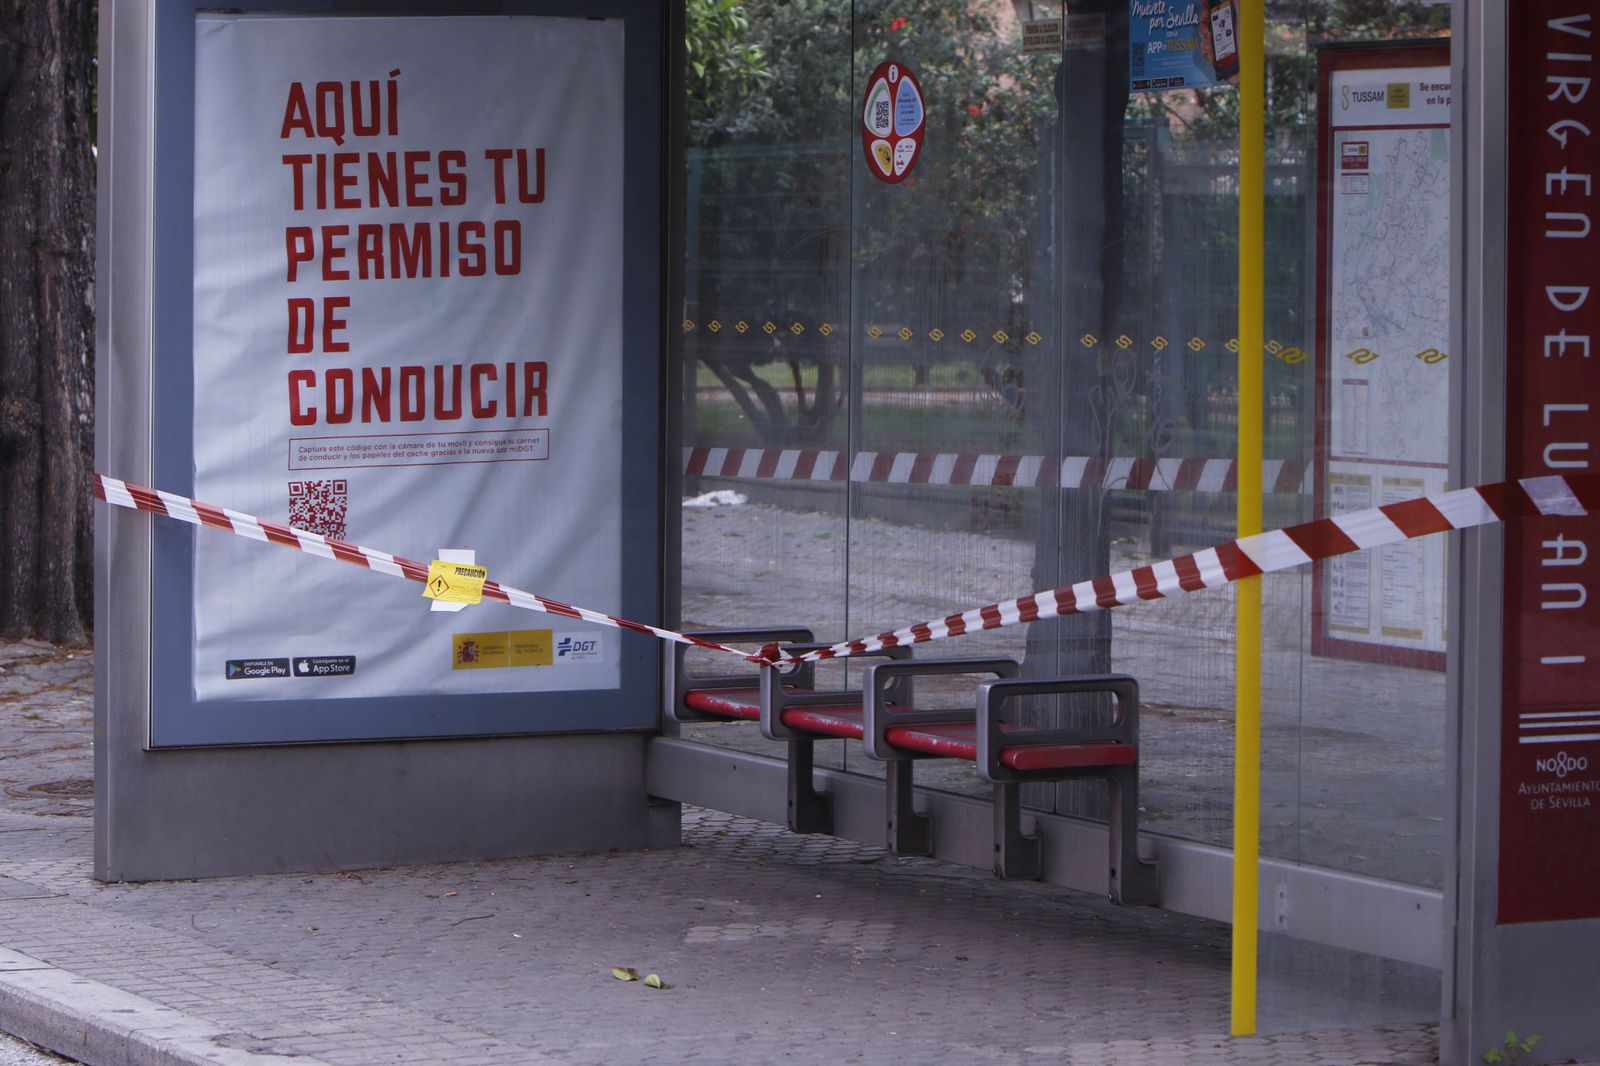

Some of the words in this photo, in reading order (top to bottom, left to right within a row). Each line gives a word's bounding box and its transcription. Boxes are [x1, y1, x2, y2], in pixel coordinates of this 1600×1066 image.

[1149, 17, 1165, 35] por
[1166, 4, 1200, 29] Sevilla
[1147, 41, 1162, 54] APP
[1168, 38, 1198, 53] TUSSAM
[1352, 92, 1384, 102] TUSSAM
[1419, 82, 1429, 91] Se
[280, 68, 400, 146] AQUÍ
[1427, 97, 1436, 105] en
[1437, 96, 1445, 104] la
[1545, 14, 1592, 238] VIRGEN
[282, 150, 467, 211] TIENES
[485, 148, 546, 204] TU
[285, 219, 522, 282] PERMISO
[287, 296, 350, 353] DE
[1544, 286, 1590, 357] DE
[287, 361, 549, 426] CONDUCIR
[298, 445, 327, 454] Captura
[347, 443, 372, 452] código
[398, 442, 423, 450] cámara
[448, 439, 467, 447] móvil
[468, 440, 473, 448] y
[474, 438, 506, 447] consigue
[516, 437, 540, 445] carnet
[309, 452, 341, 461] conducir
[362, 451, 391, 460] papeles
[392, 450, 405, 458] del
[407, 449, 428, 457] coche
[430, 448, 456, 457] gracias
[1541, 404, 1589, 610] LUAN
[572, 640, 597, 652] DGT
[244, 666, 270, 676] Google
[271, 665, 286, 675] Play
[313, 664, 329, 673] App
[330, 664, 350, 672] Store
